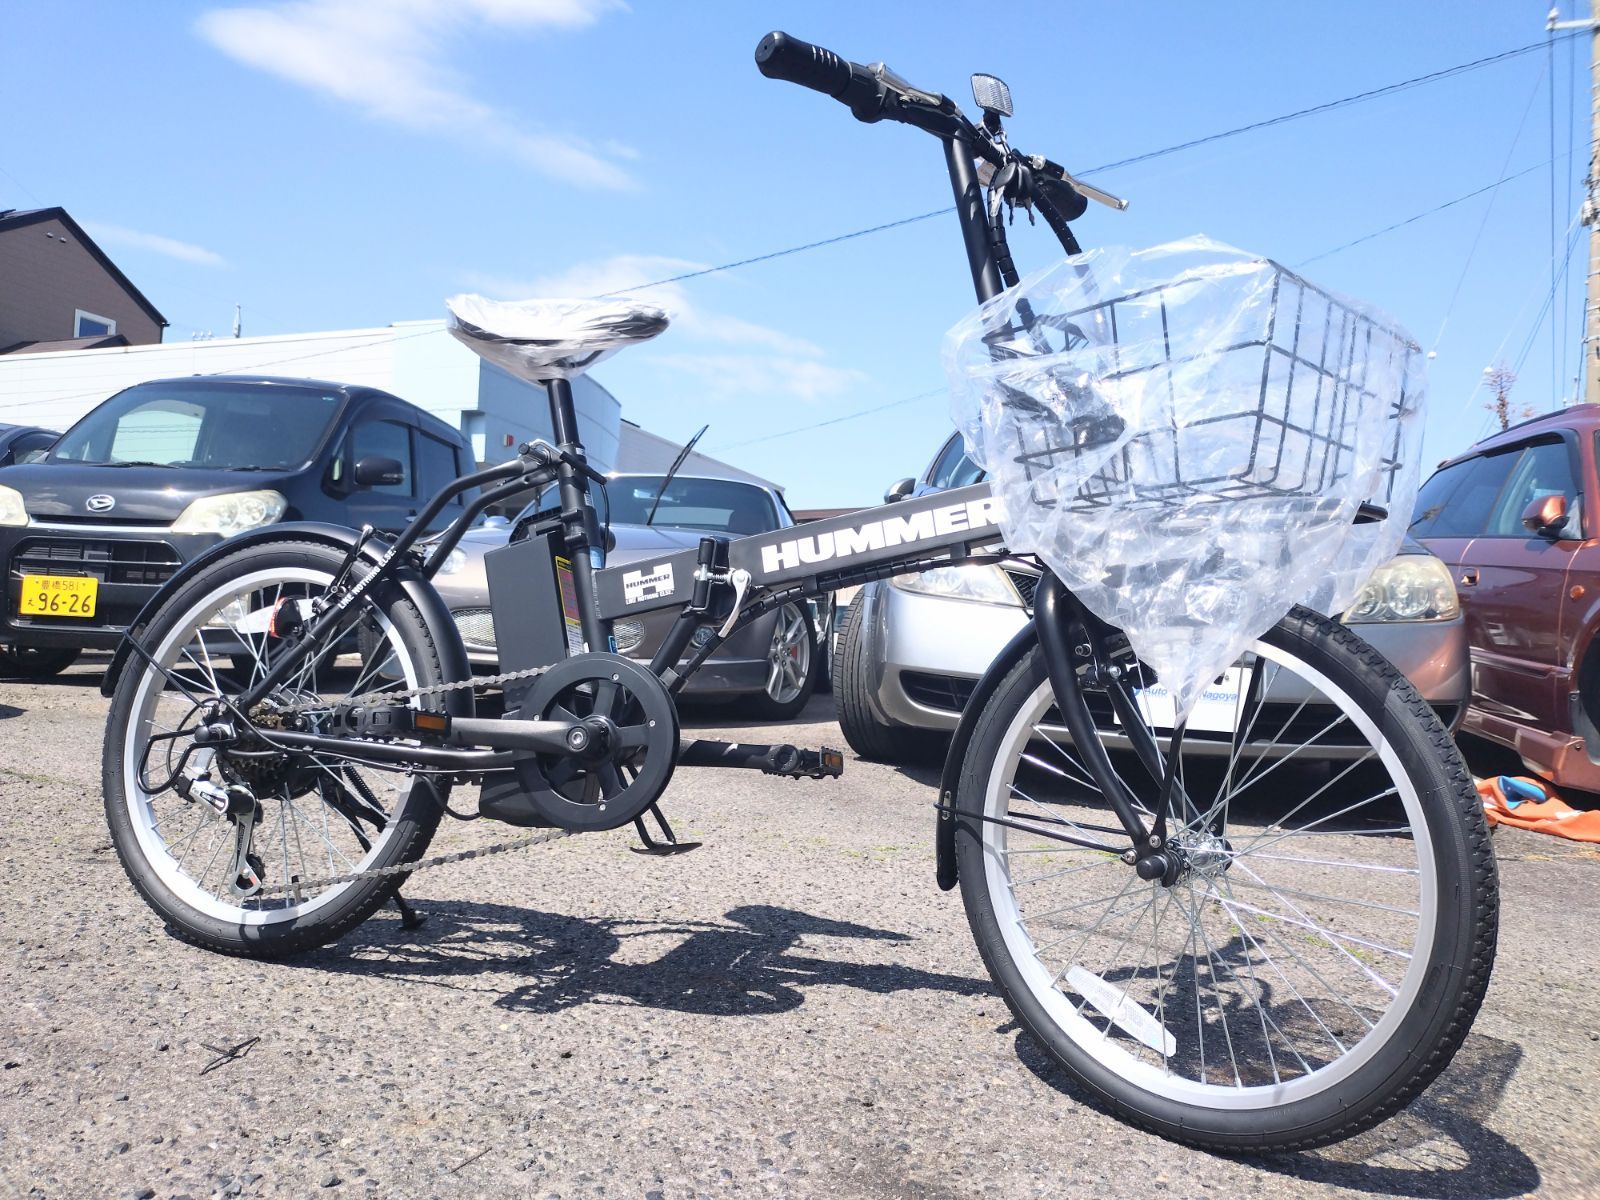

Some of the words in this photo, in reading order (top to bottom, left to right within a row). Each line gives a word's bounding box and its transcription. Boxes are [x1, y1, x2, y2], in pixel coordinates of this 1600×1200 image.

[761, 496, 1002, 574] HUMMER
[338, 592, 354, 609] LIKE
[352, 565, 381, 595] NOTHING
[625, 573, 671, 589] HUMMER
[38, 592, 92, 613] 96-26
